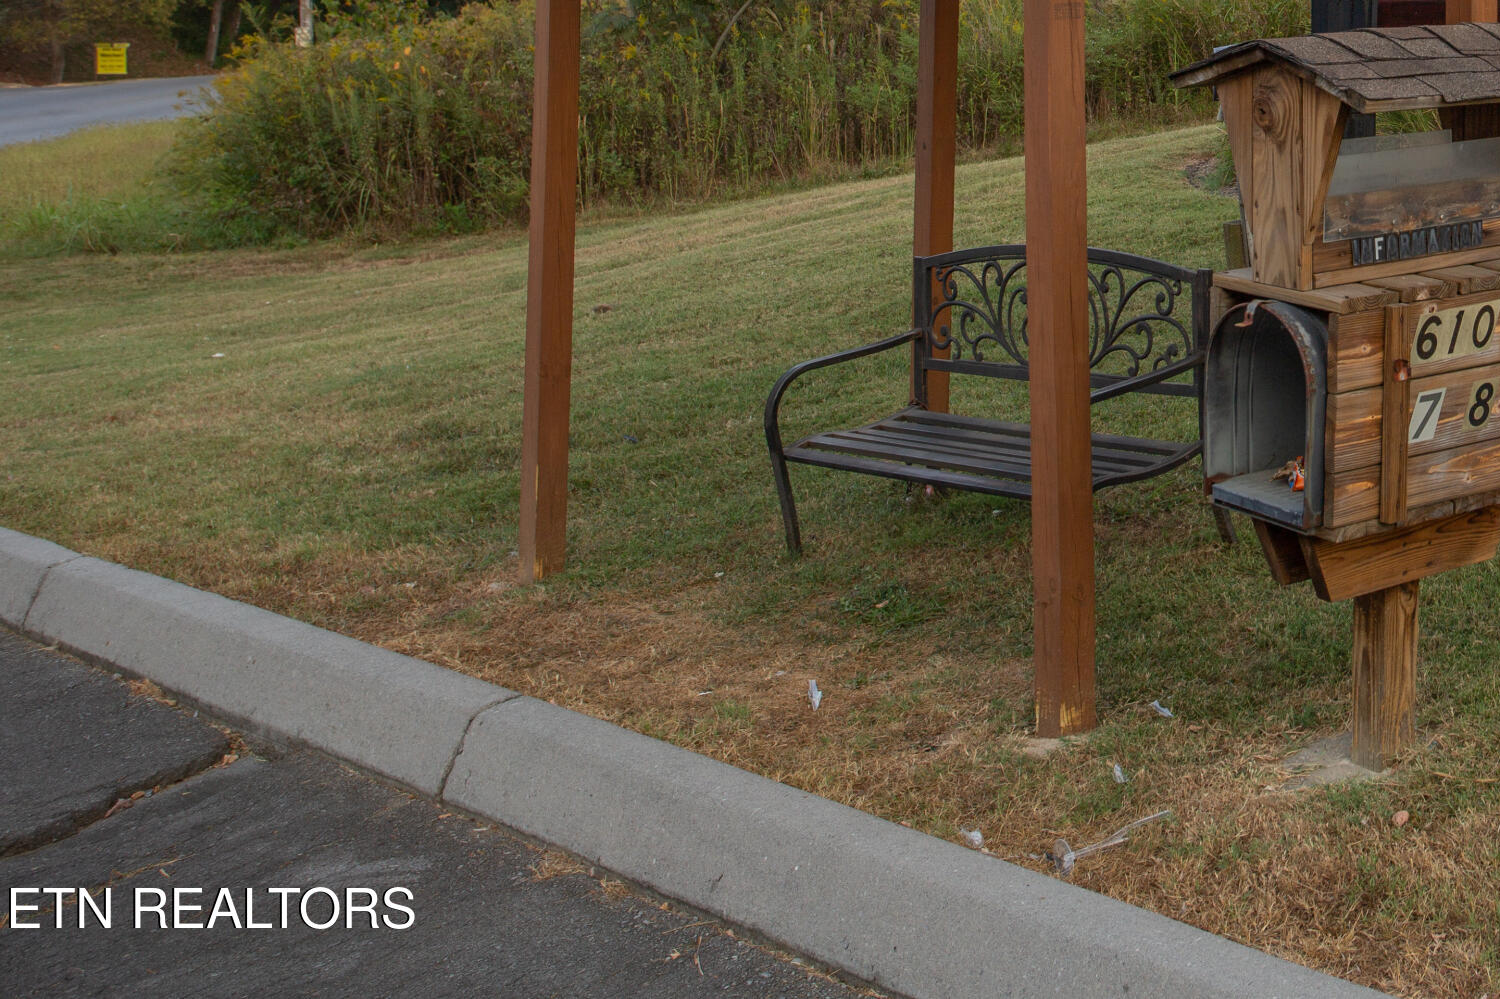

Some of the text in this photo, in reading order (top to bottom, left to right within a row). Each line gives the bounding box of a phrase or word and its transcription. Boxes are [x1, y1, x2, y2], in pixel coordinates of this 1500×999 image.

[1416, 304, 1495, 360] 610
[1411, 382, 1494, 440] 7 8
